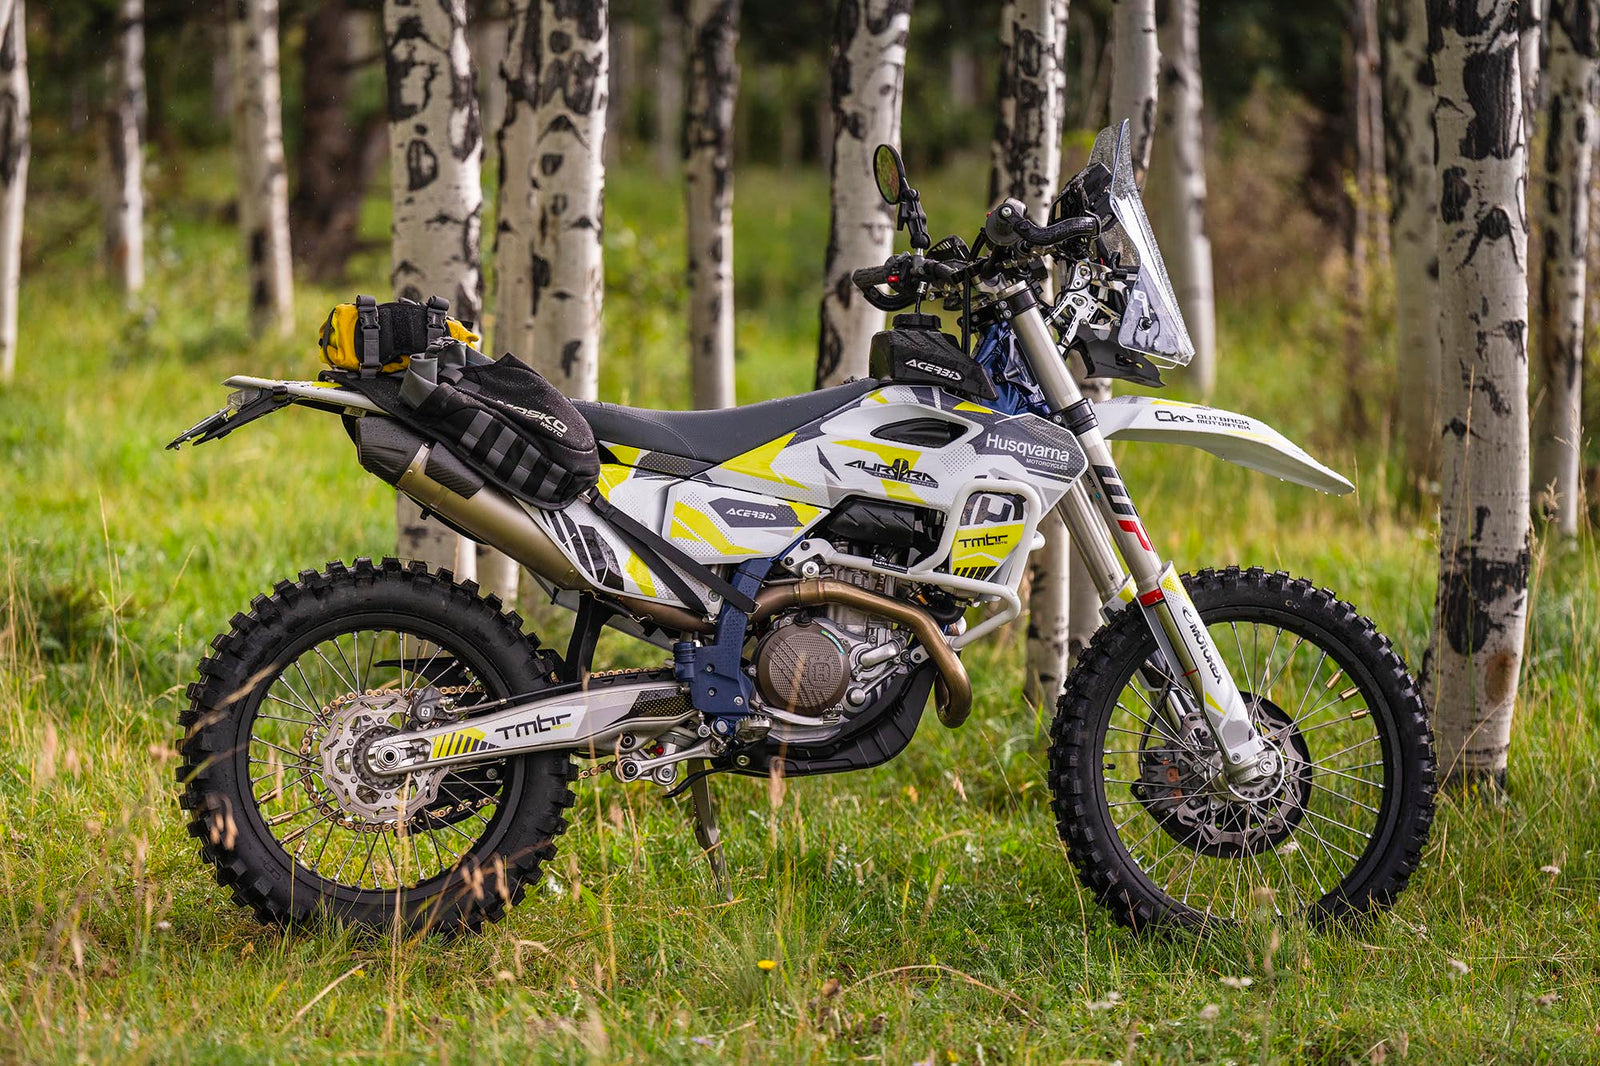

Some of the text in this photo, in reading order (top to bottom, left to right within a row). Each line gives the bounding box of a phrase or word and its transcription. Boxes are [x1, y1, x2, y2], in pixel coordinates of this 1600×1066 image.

[540, 421, 564, 438] MOTO
[985, 432, 1070, 463] Husqvarna
[1189, 623, 1222, 685] MOTOREX
